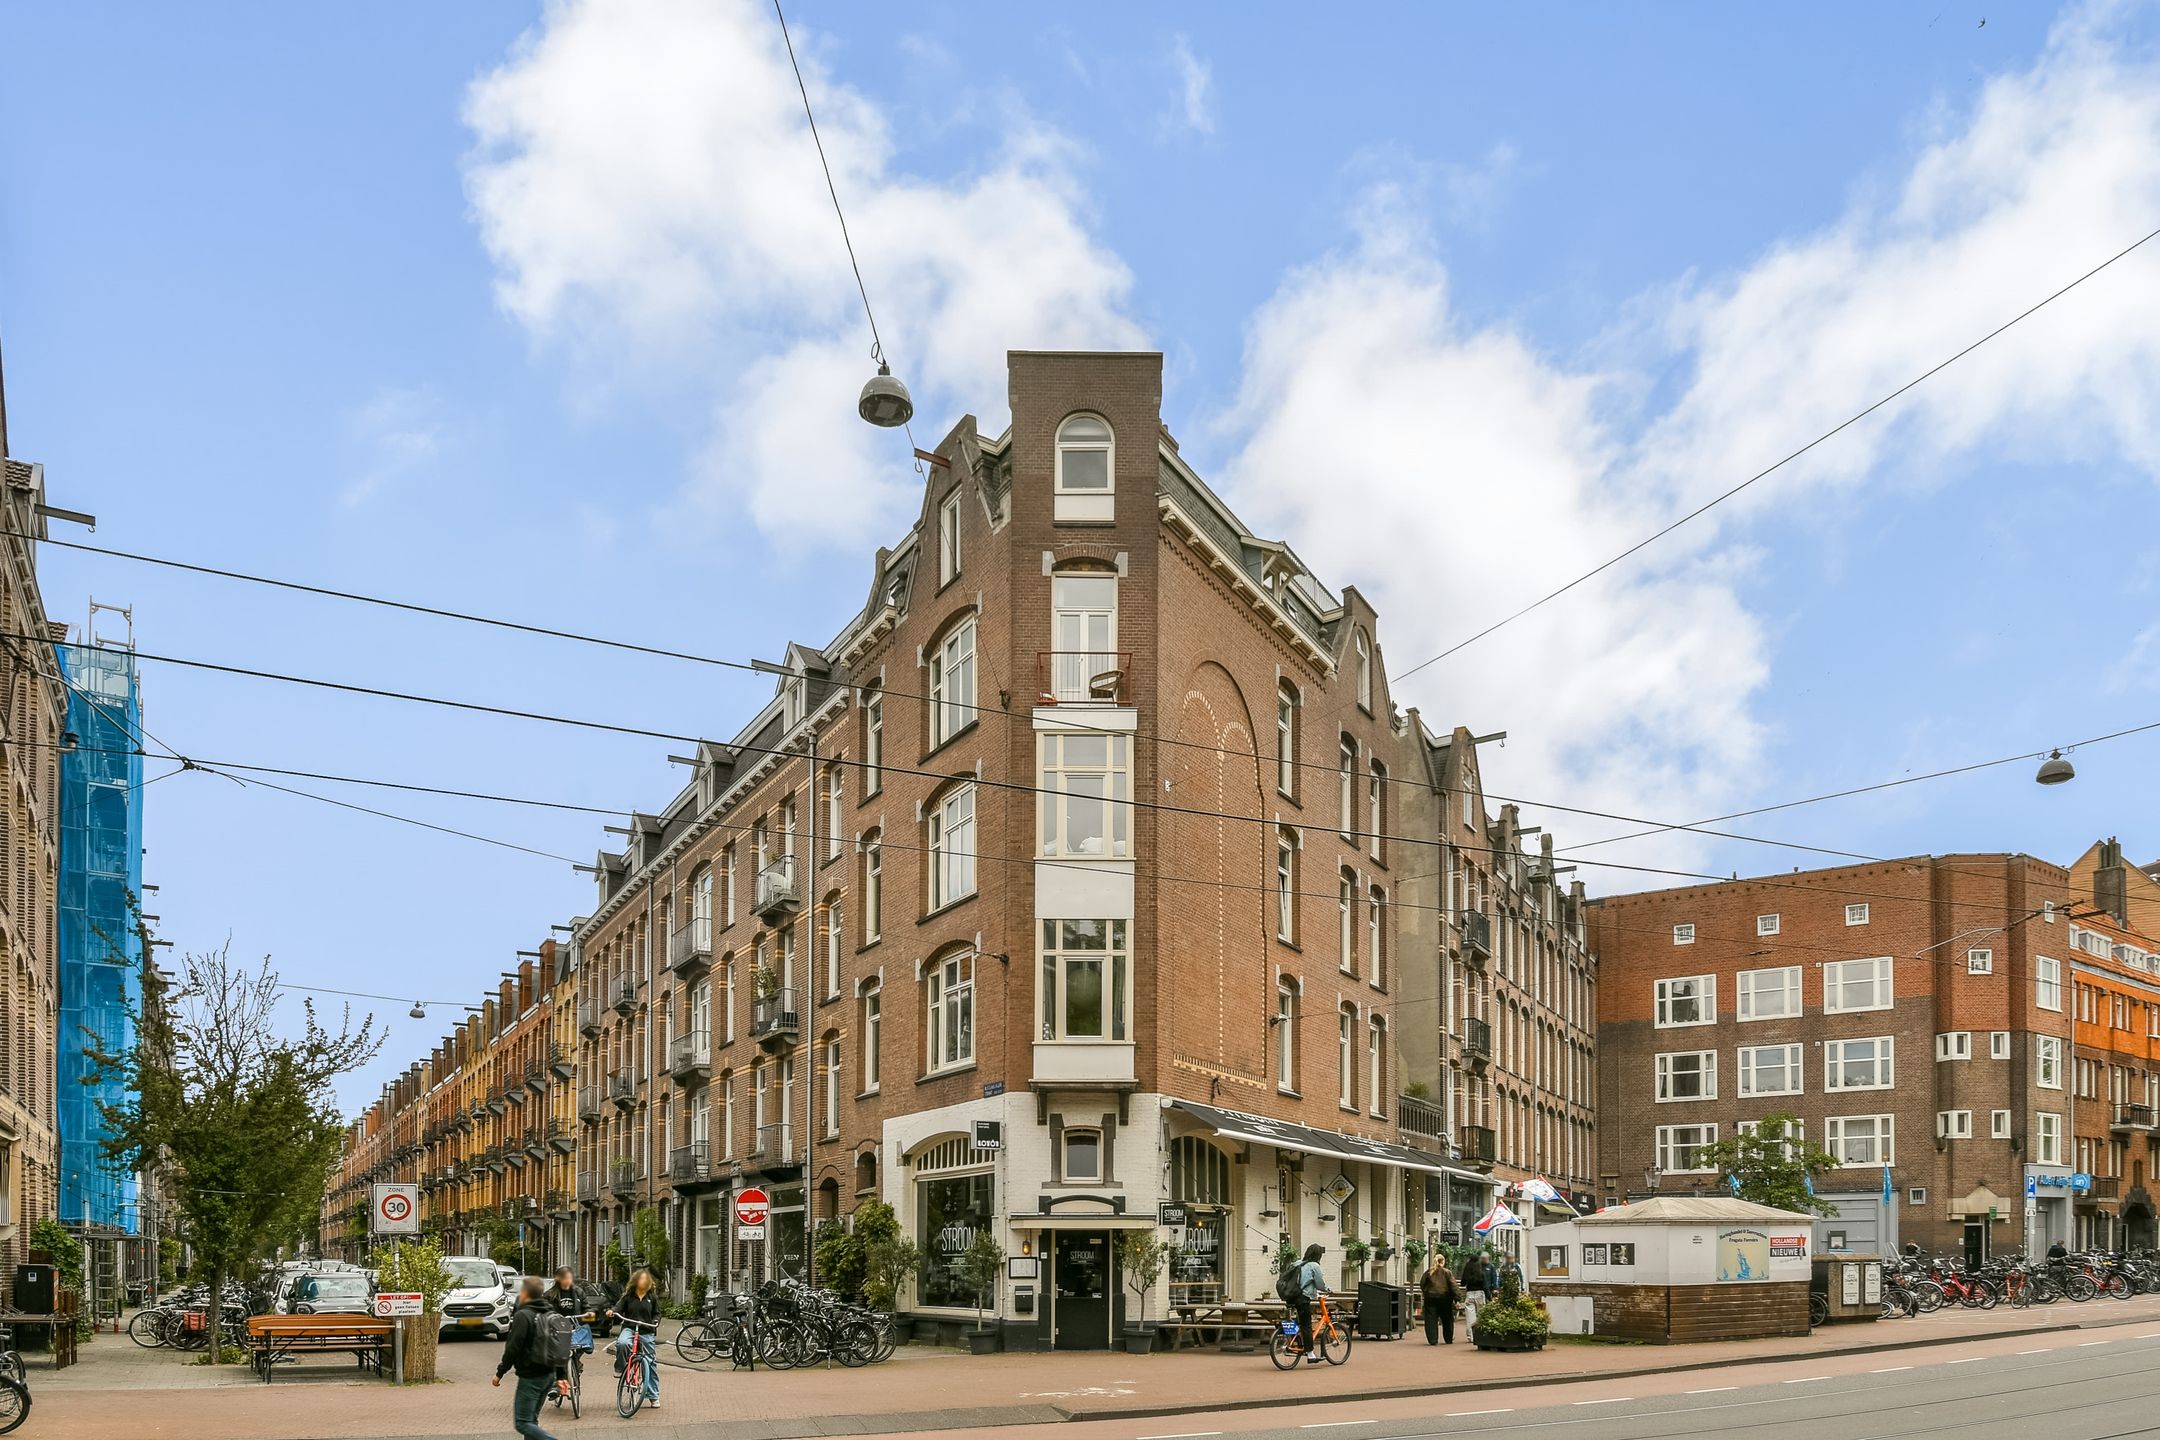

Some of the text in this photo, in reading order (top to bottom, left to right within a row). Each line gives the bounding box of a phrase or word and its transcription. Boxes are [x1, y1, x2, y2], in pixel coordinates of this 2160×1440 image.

[388, 1202, 405, 1212] 30
[1164, 1209, 1183, 1217] STROOM
[942, 1226, 976, 1251] STROOM
[1070, 1250, 1095, 1260] STROOM
[1771, 1248, 1799, 1256] NIEUWE
